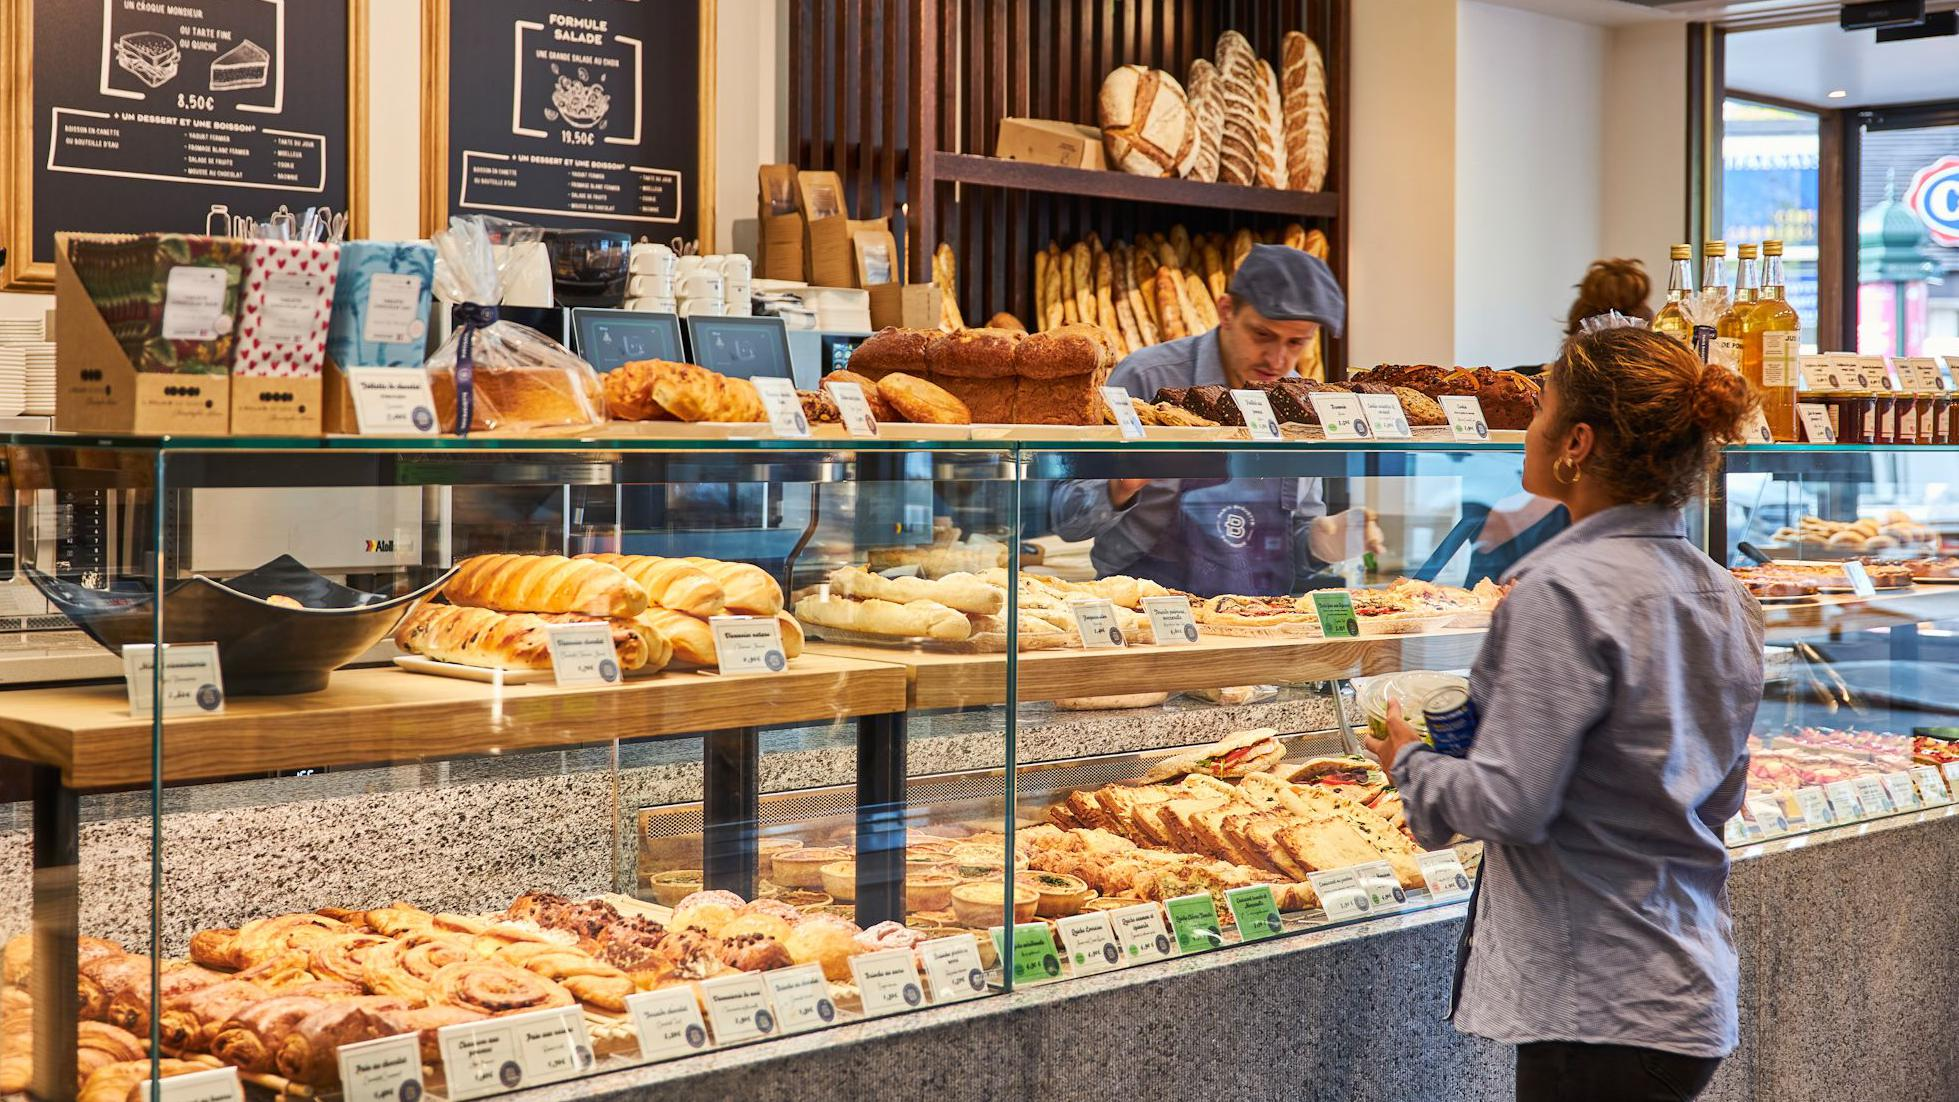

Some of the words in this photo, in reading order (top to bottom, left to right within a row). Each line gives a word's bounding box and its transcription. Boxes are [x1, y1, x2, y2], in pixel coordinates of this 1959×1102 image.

[136, 1, 165, 13] CROQUE
[167, 5, 203, 19] MONSIEUR
[549, 13, 608, 32] FORMULE
[192, 27, 215, 39] TARTE
[216, 30, 232, 41] FINE
[554, 28, 603, 45] SALADE
[191, 40, 217, 52] QUICHE
[177, 93, 215, 111] 8.50€
[121, 112, 135, 121] UN
[137, 113, 178, 126] DESSERT
[180, 118, 191, 127] ET
[193, 119, 212, 129] UNE
[518, 154, 529, 163] UN
[530, 155, 563, 166] DESSERT
[564, 158, 574, 167] ET
